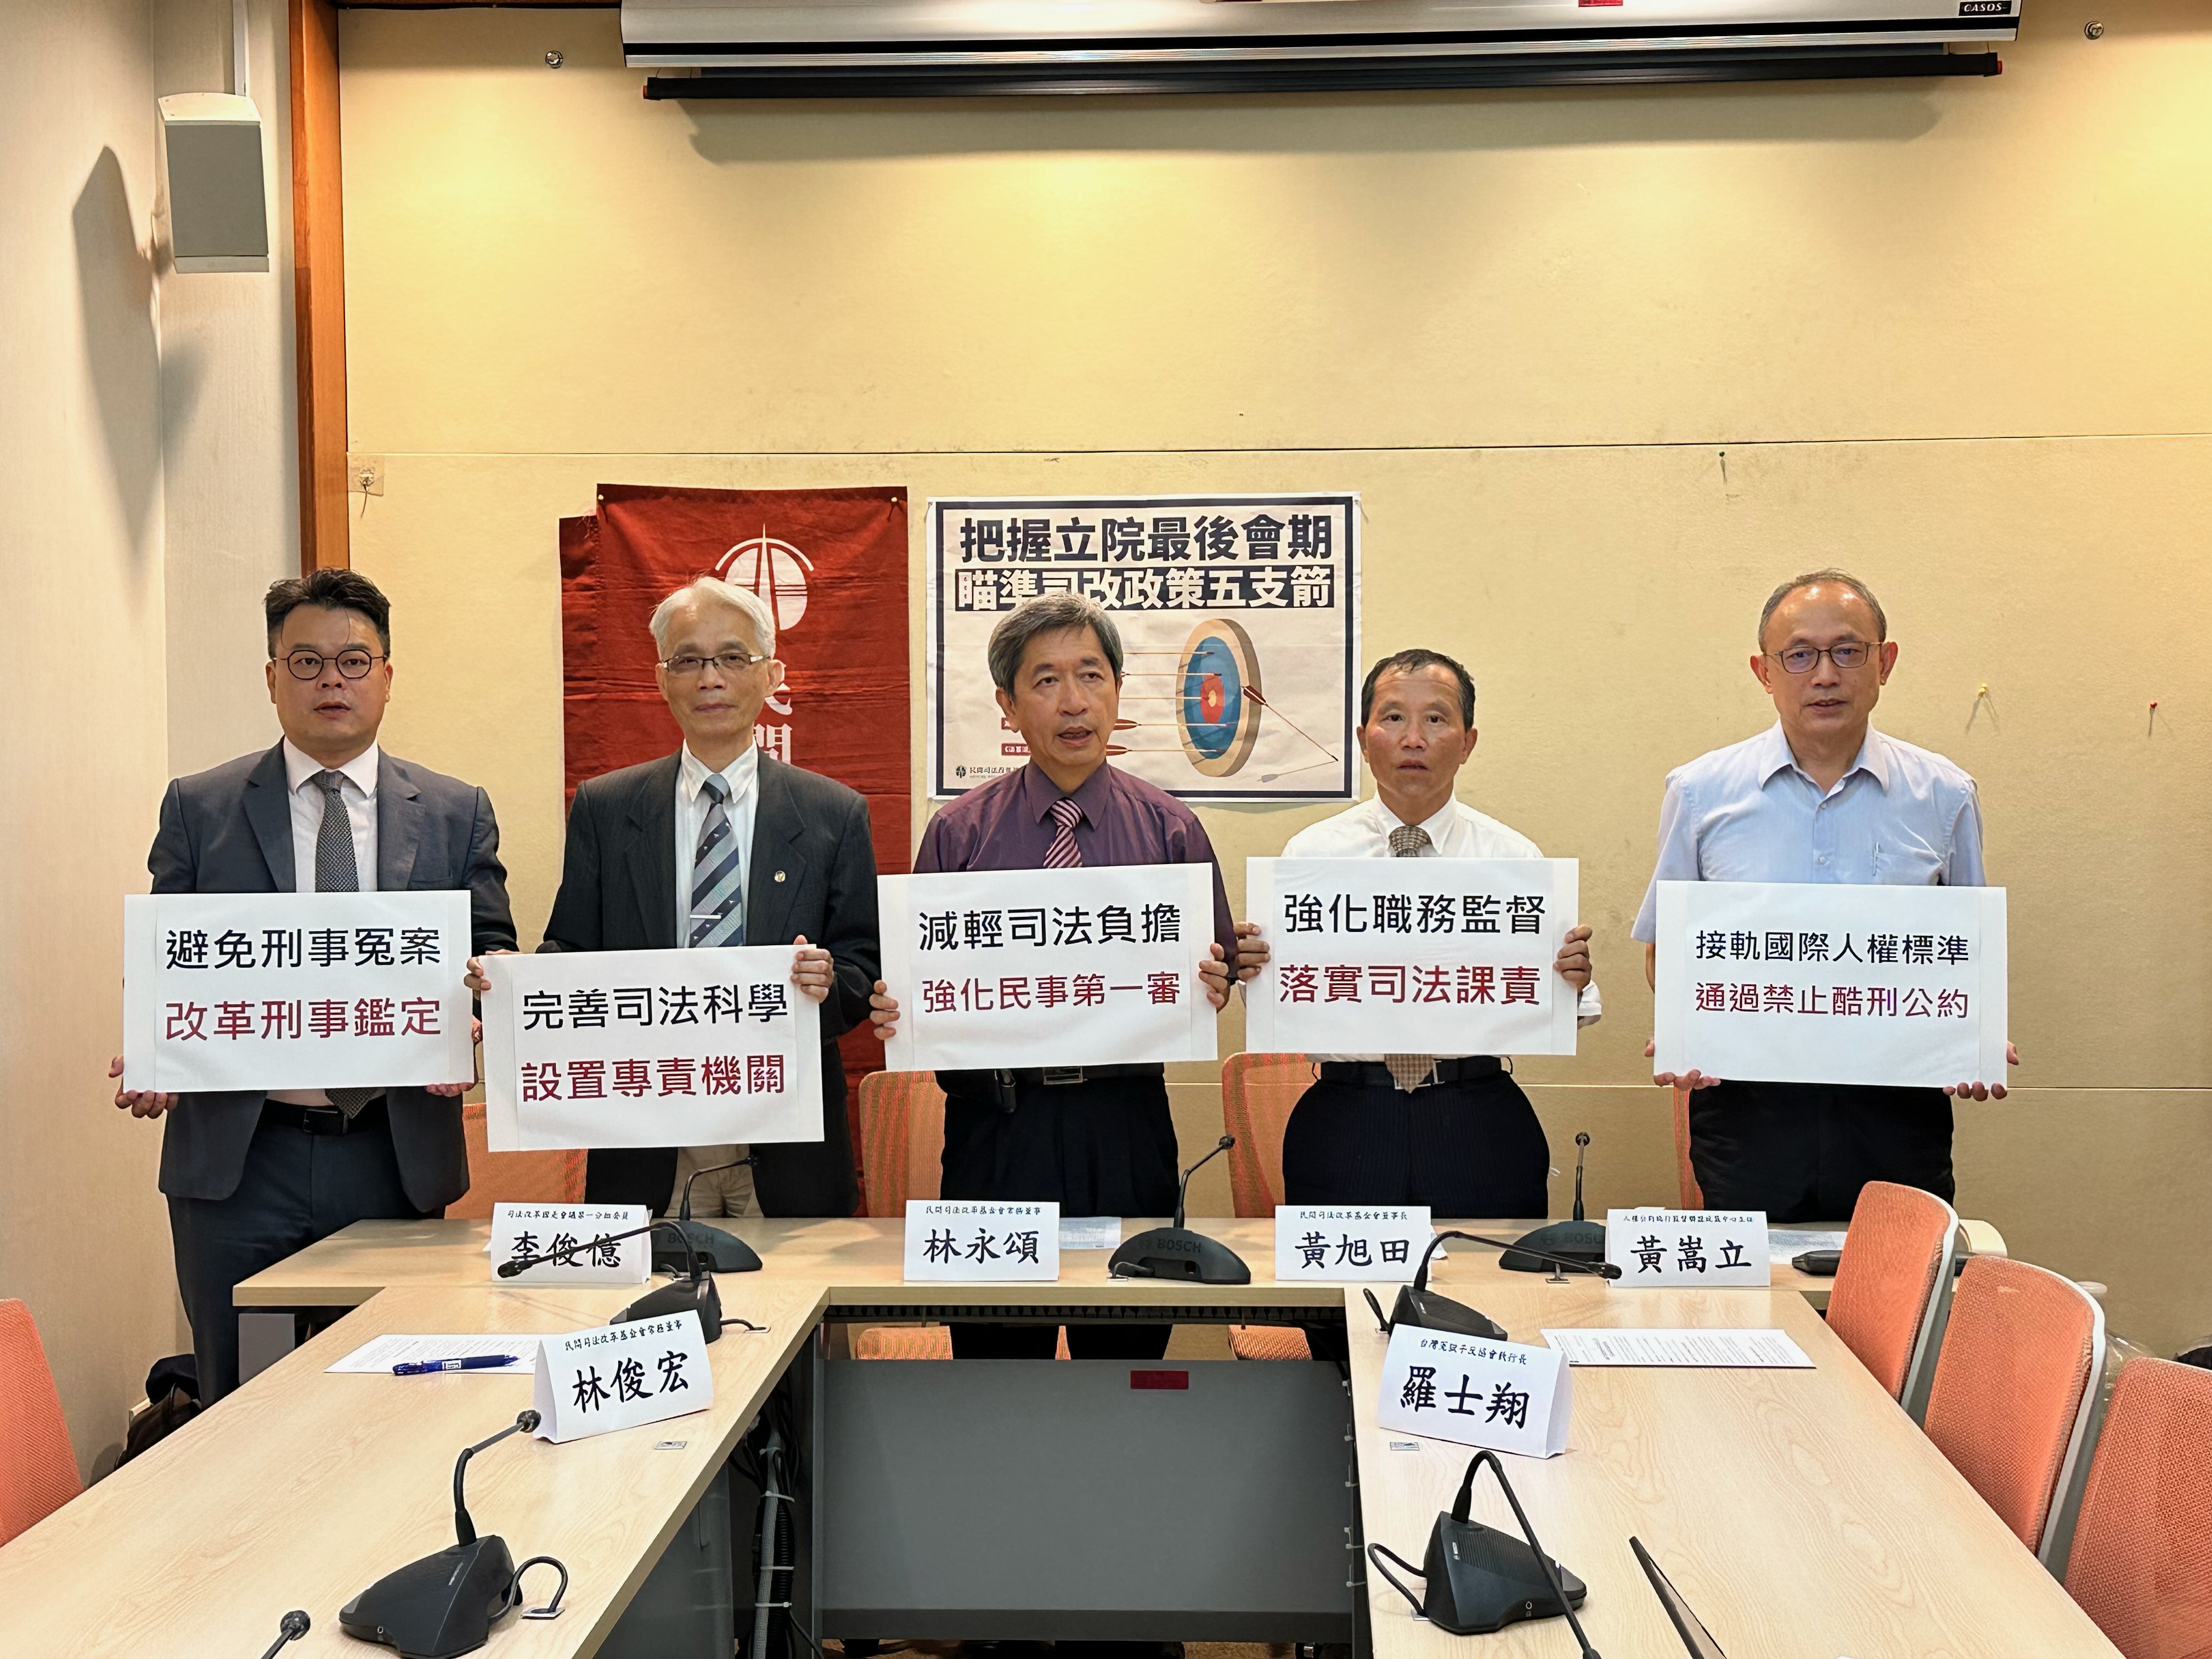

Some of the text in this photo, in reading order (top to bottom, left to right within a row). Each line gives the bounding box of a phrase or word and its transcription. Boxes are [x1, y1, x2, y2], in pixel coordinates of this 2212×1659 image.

[1964, 3, 2002, 12] CASOS
[960, 514, 1332, 563] 把握立院最後會期
[919, 902, 1181, 951] 減輕司法負擔
[1284, 893, 1545, 934] 強化職務監督
[166, 927, 441, 969] 避免刑事冤案
[1696, 930, 1969, 966] 接軌國際人權標準
[922, 970, 1180, 1013] 強化民事第一審
[1279, 964, 1541, 1006] 落實司法課責
[1695, 982, 1968, 1018] 通過禁止酷刑公約
[166, 997, 441, 1041] 改革刑事鑑定
[523, 983, 788, 1031] 完善司法科學
[521, 1054, 785, 1102] 設置專責機關
[511, 1231, 621, 1268] 李俊億
[923, 1227, 1040, 1265] 林永頌
[1157, 1239, 1201, 1253] BOSCH
[1294, 1231, 1410, 1269] 黃旭田
[1630, 1234, 1752, 1274] 黃嵩立
[572, 1350, 689, 1413] 林俊宏
[1400, 1365, 1530, 1429] 羅士翔
